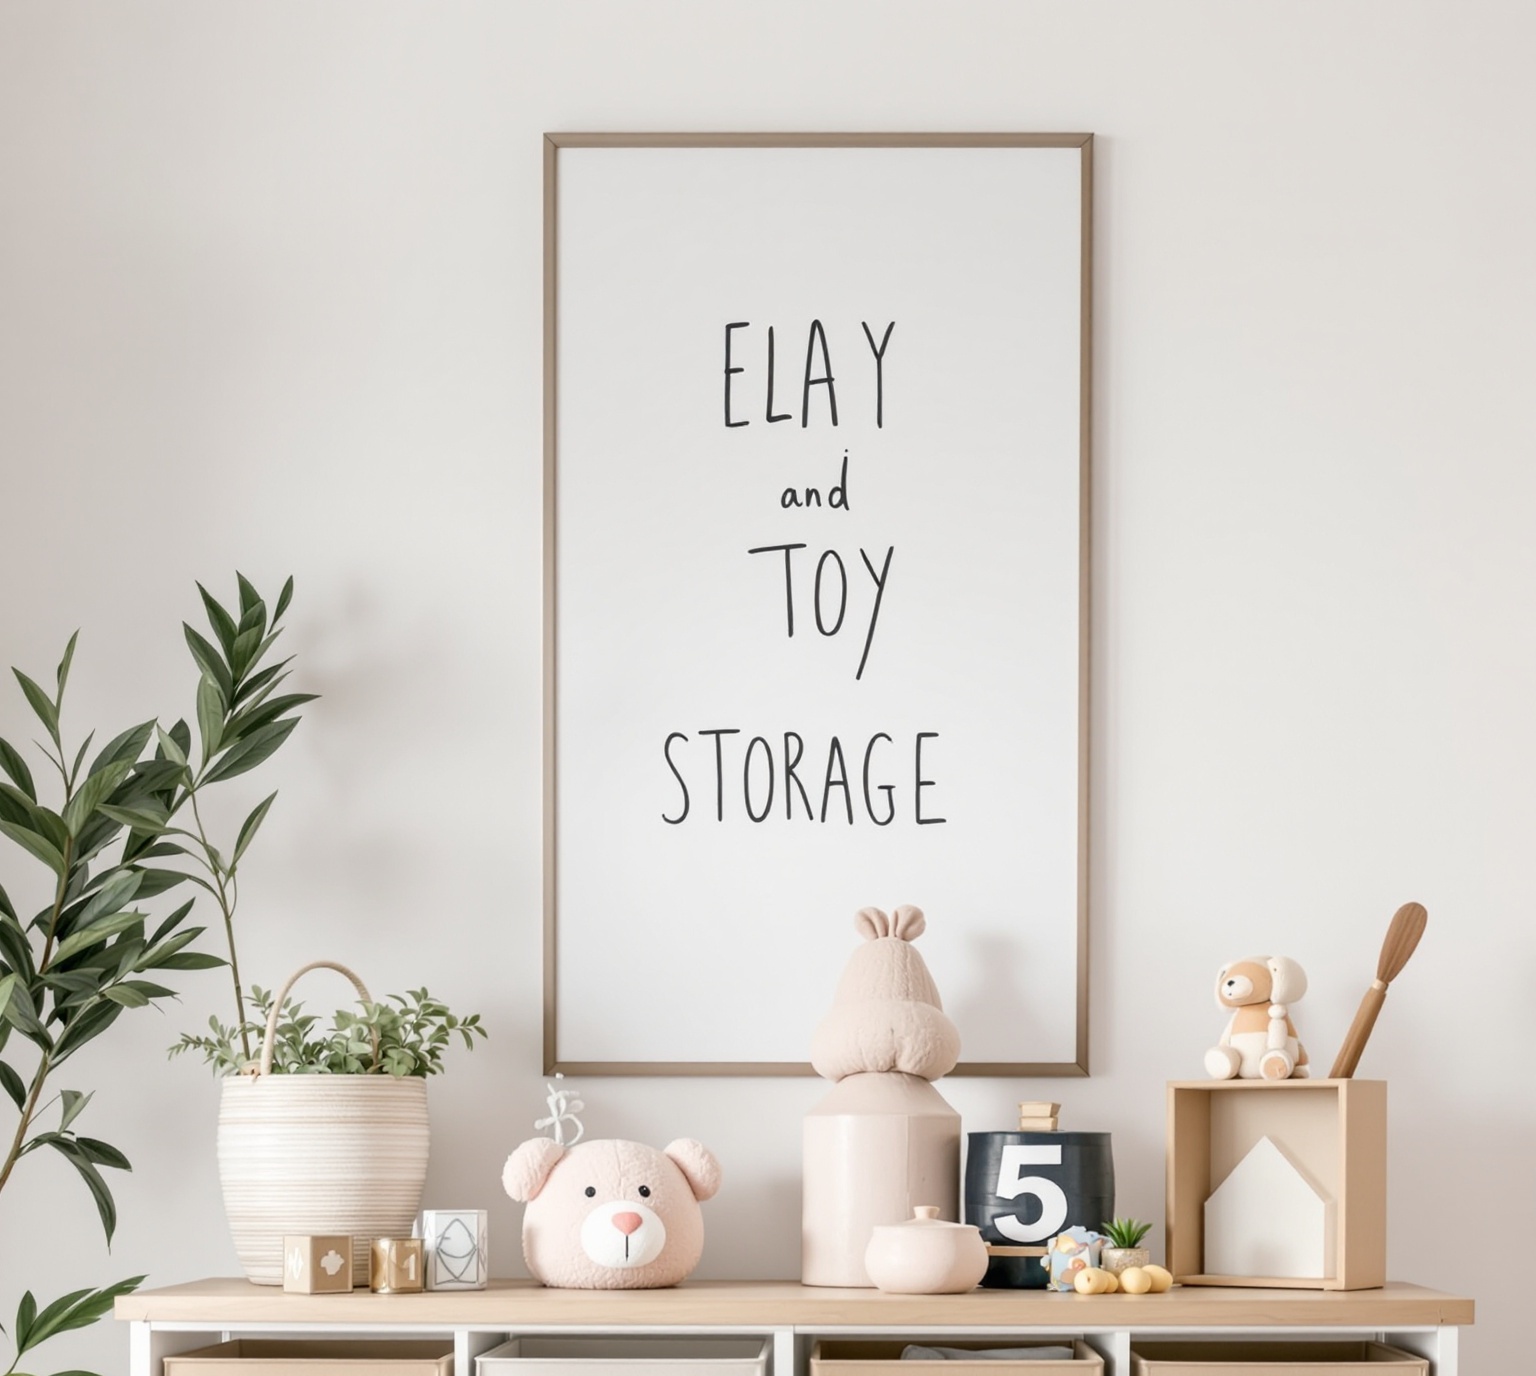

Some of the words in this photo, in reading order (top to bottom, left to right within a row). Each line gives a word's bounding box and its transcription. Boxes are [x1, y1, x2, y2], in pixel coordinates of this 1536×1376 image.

[724, 319, 896, 429] ELAY
[780, 448, 850, 511] and
[747, 542, 894, 681] TOY
[661, 729, 947, 826] STORAGE
[994, 1144, 1068, 1243] 5
